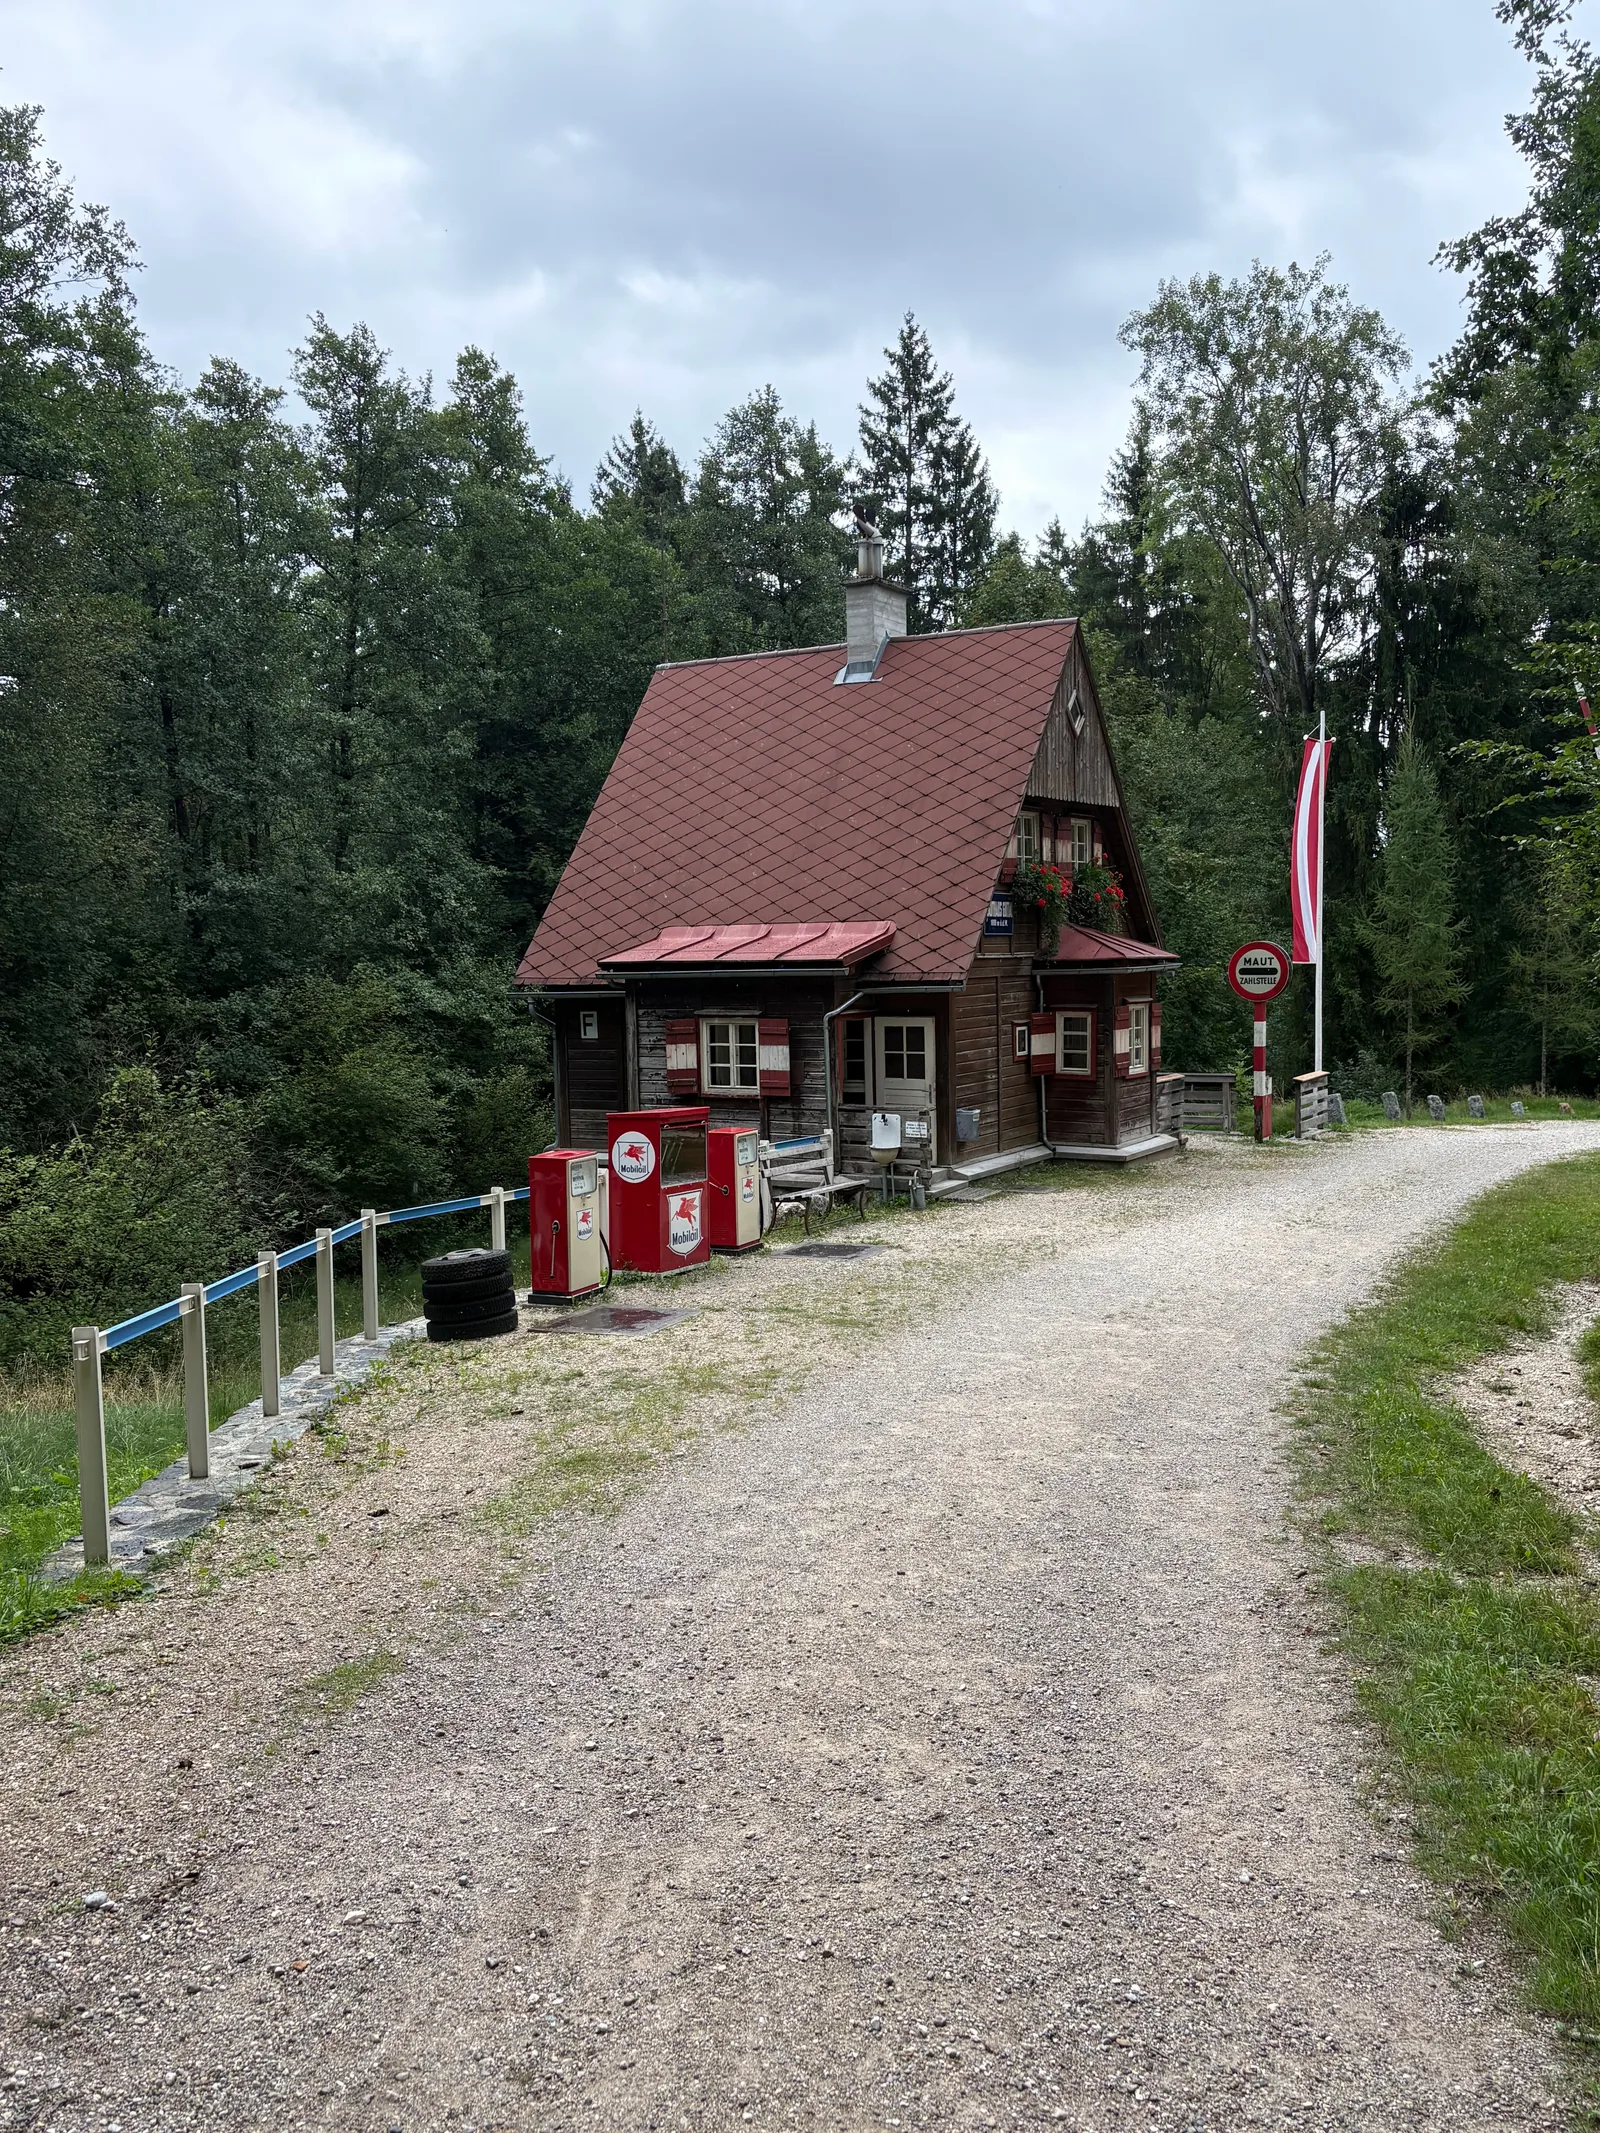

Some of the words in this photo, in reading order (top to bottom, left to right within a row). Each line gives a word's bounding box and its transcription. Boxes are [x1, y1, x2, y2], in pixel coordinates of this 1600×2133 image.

[1243, 957, 1274, 966] MAUT
[1240, 977, 1277, 985] ZAHLSTELLE
[620, 1164, 647, 1173] Mobiloil
[672, 1228, 699, 1246] Mobiloil
